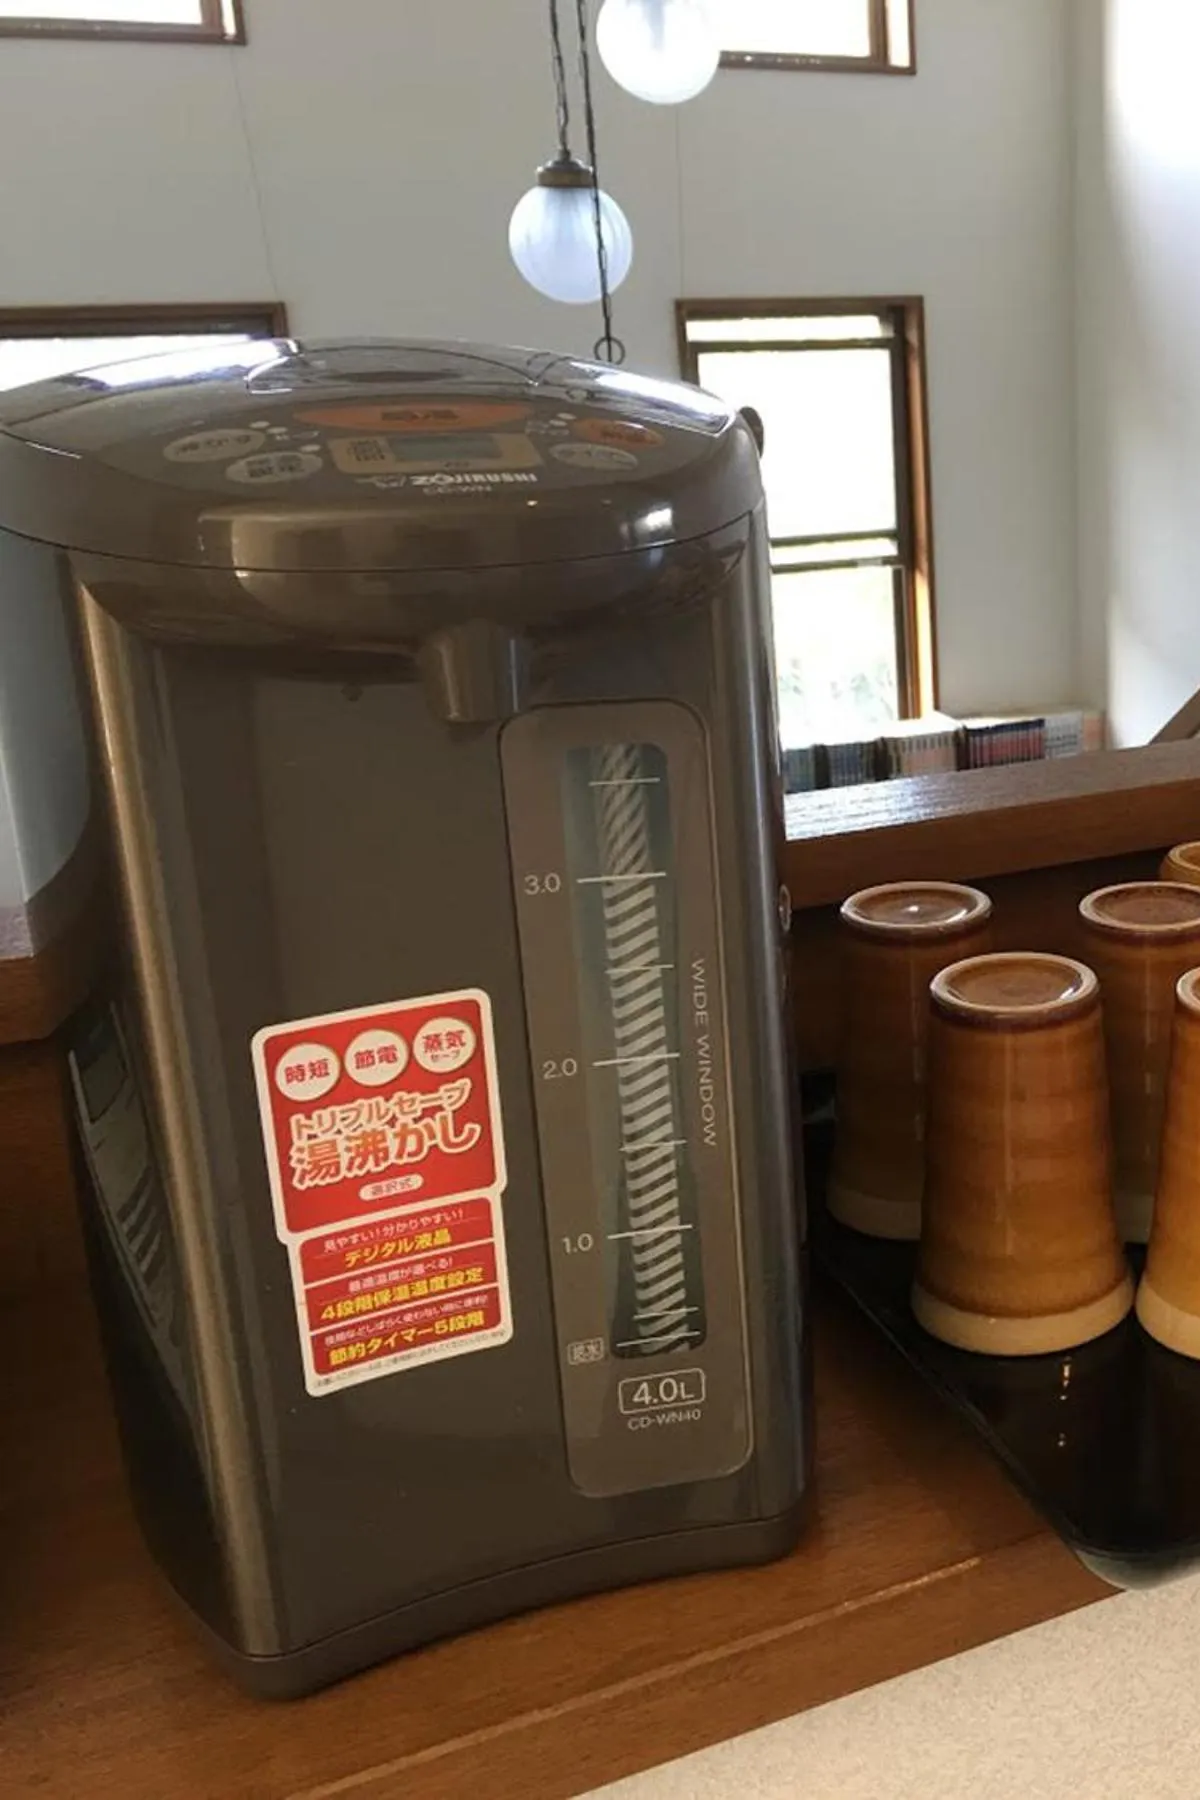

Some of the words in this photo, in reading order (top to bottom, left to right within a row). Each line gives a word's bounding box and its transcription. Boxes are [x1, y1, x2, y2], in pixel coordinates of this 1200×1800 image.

[409, 472, 538, 486] ZOJIRUSHI
[524, 873, 561, 895] 3.0
[691, 958, 709, 1026] WIDE
[354, 1044, 399, 1070] 節電
[543, 1058, 577, 1080] 2.0
[284, 1058, 330, 1085] 時短
[696, 1034, 717, 1146] WINDOW
[291, 1079, 470, 1141] トリプルセーブ
[291, 1110, 481, 1189] 湯沸かし
[344, 1227, 452, 1268] デジタル液晶
[562, 1233, 594, 1254] 1.0
[632, 1377, 695, 1405] 4.0L
